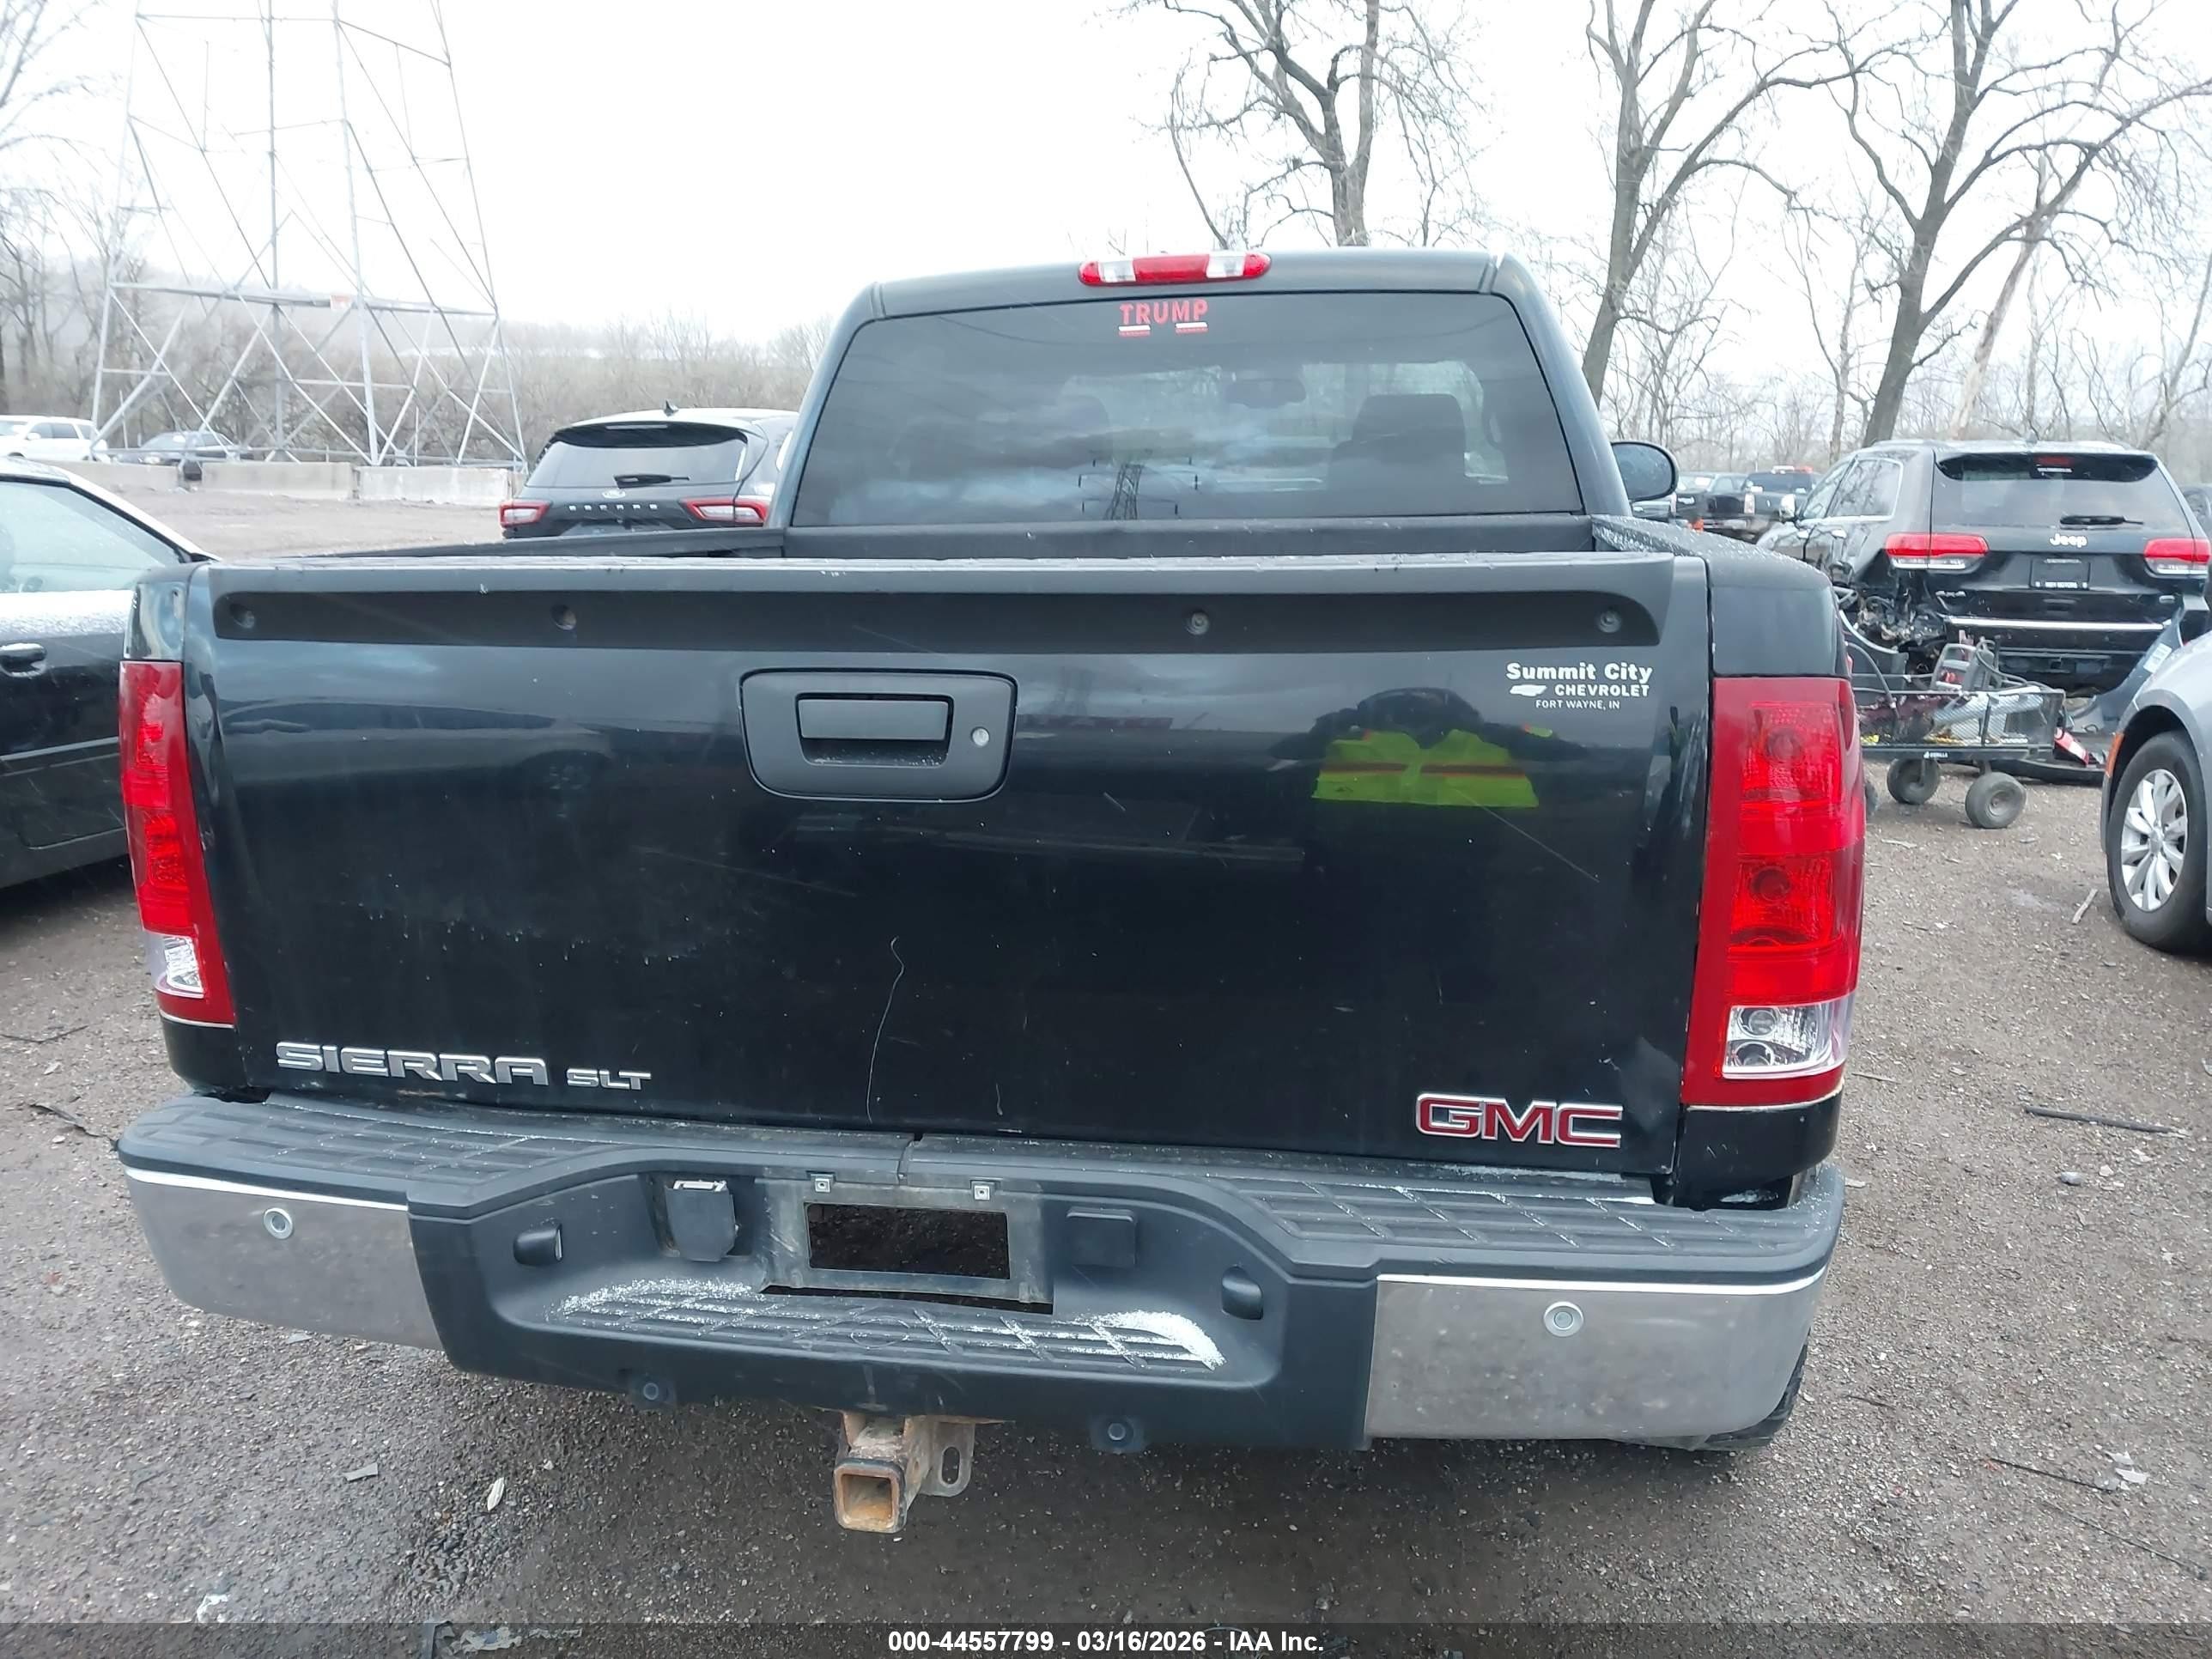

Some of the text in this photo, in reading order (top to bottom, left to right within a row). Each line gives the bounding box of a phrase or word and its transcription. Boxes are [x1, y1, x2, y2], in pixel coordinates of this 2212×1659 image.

[1119, 299, 1208, 325] TRUMP
[2049, 533, 2087, 548] Jeep
[1506, 662, 1653, 684] Summit City
[1554, 684, 1650, 696] CHEVROLET
[1535, 700, 1620, 710] FORT WAYNE, IN
[276, 1041, 651, 1091] SIERRA SLT
[1416, 1093, 1624, 1149] GMC
